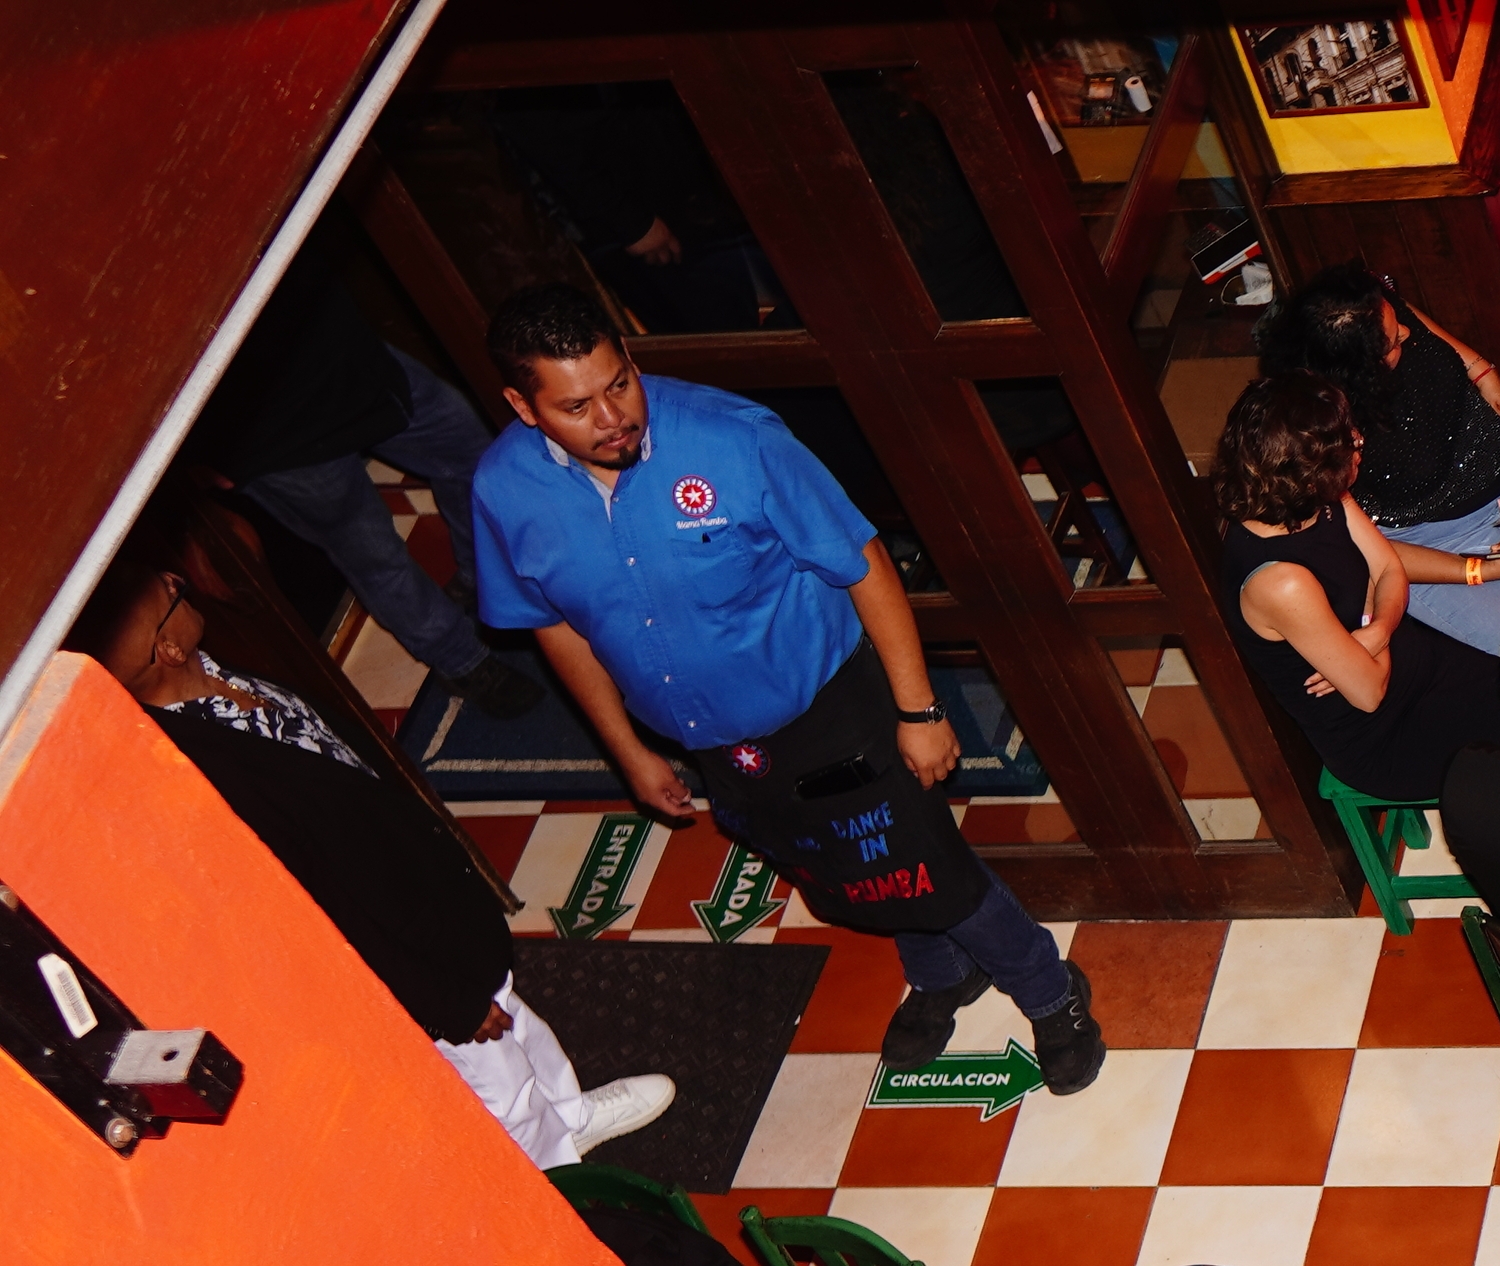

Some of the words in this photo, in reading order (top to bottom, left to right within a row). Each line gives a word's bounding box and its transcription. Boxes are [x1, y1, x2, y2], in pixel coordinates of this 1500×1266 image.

[676, 520, 700, 530] Mama
[700, 517, 728, 526] Rumba
[831, 801, 894, 840] DANCE
[858, 833, 890, 863] IN
[572, 824, 635, 930] ENTRADA
[842, 862, 935, 903] RUMBA
[890, 1073, 1011, 1088] CIRCULACION
